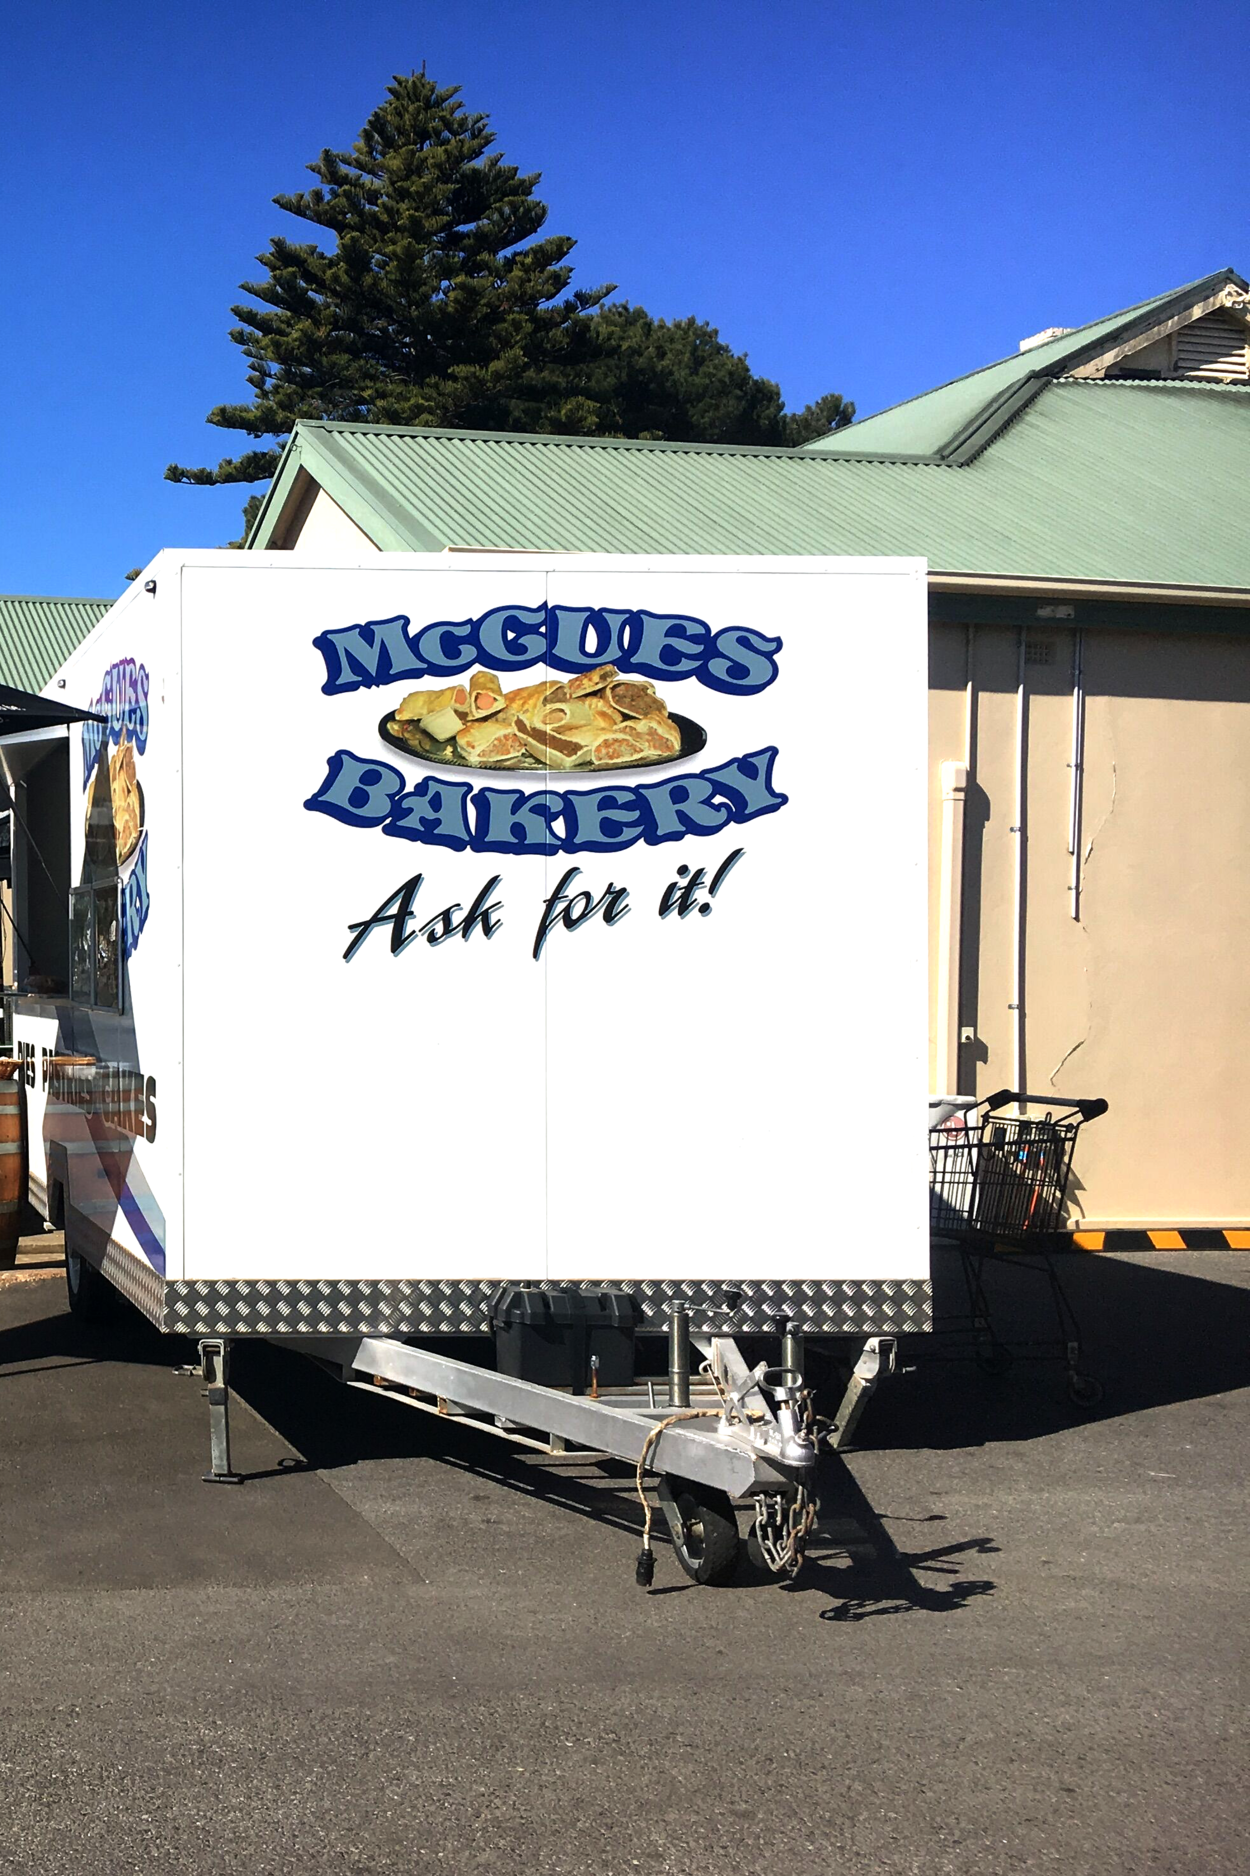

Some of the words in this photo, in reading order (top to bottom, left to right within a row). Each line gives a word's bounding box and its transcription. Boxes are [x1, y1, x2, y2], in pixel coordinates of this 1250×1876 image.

[304, 745, 789, 856] BAKERY
[342, 873, 504, 963] Ask
[533, 866, 632, 961] for
[658, 848, 747, 918] it!
